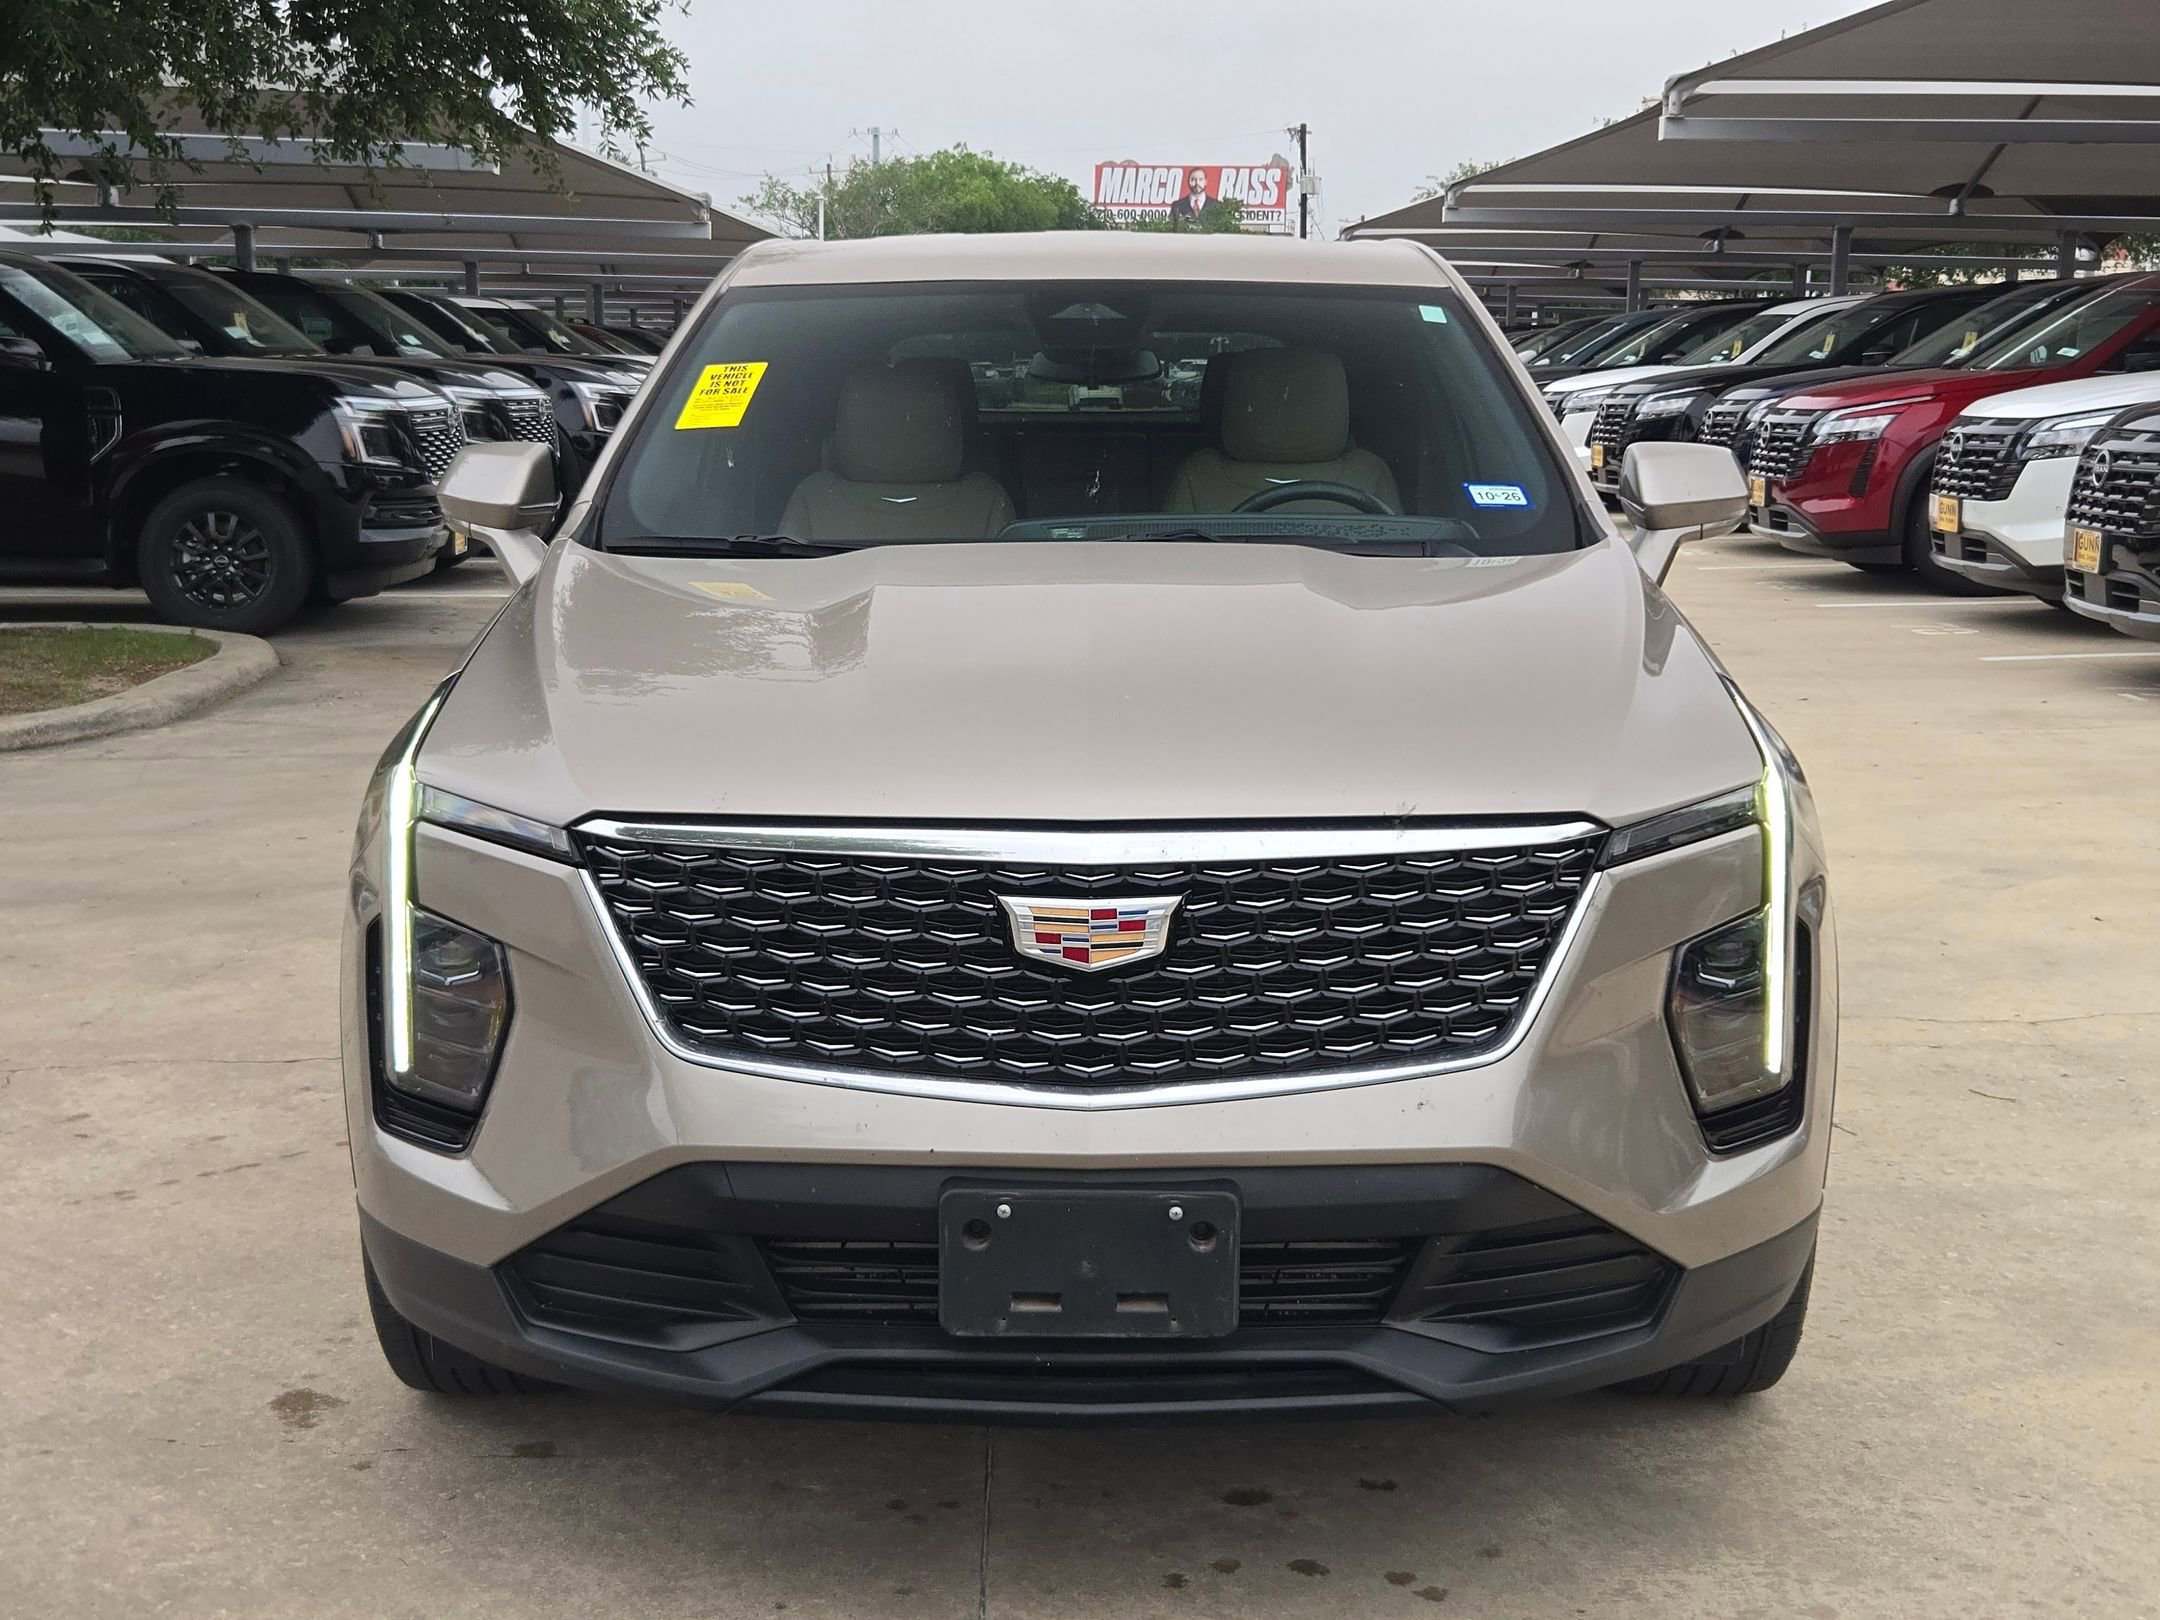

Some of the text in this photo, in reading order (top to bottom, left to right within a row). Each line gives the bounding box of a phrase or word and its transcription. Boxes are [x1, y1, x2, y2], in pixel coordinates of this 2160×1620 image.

[1099, 167, 1183, 205] MARCO
[723, 365, 749, 373] THIS
[711, 372, 753, 380] VEHICLE
[723, 387, 749, 395] SALE
[1477, 491, 1521, 502] 10-26
[1939, 501, 1956, 517] GUNN
[2078, 533, 2100, 553] GUNN
